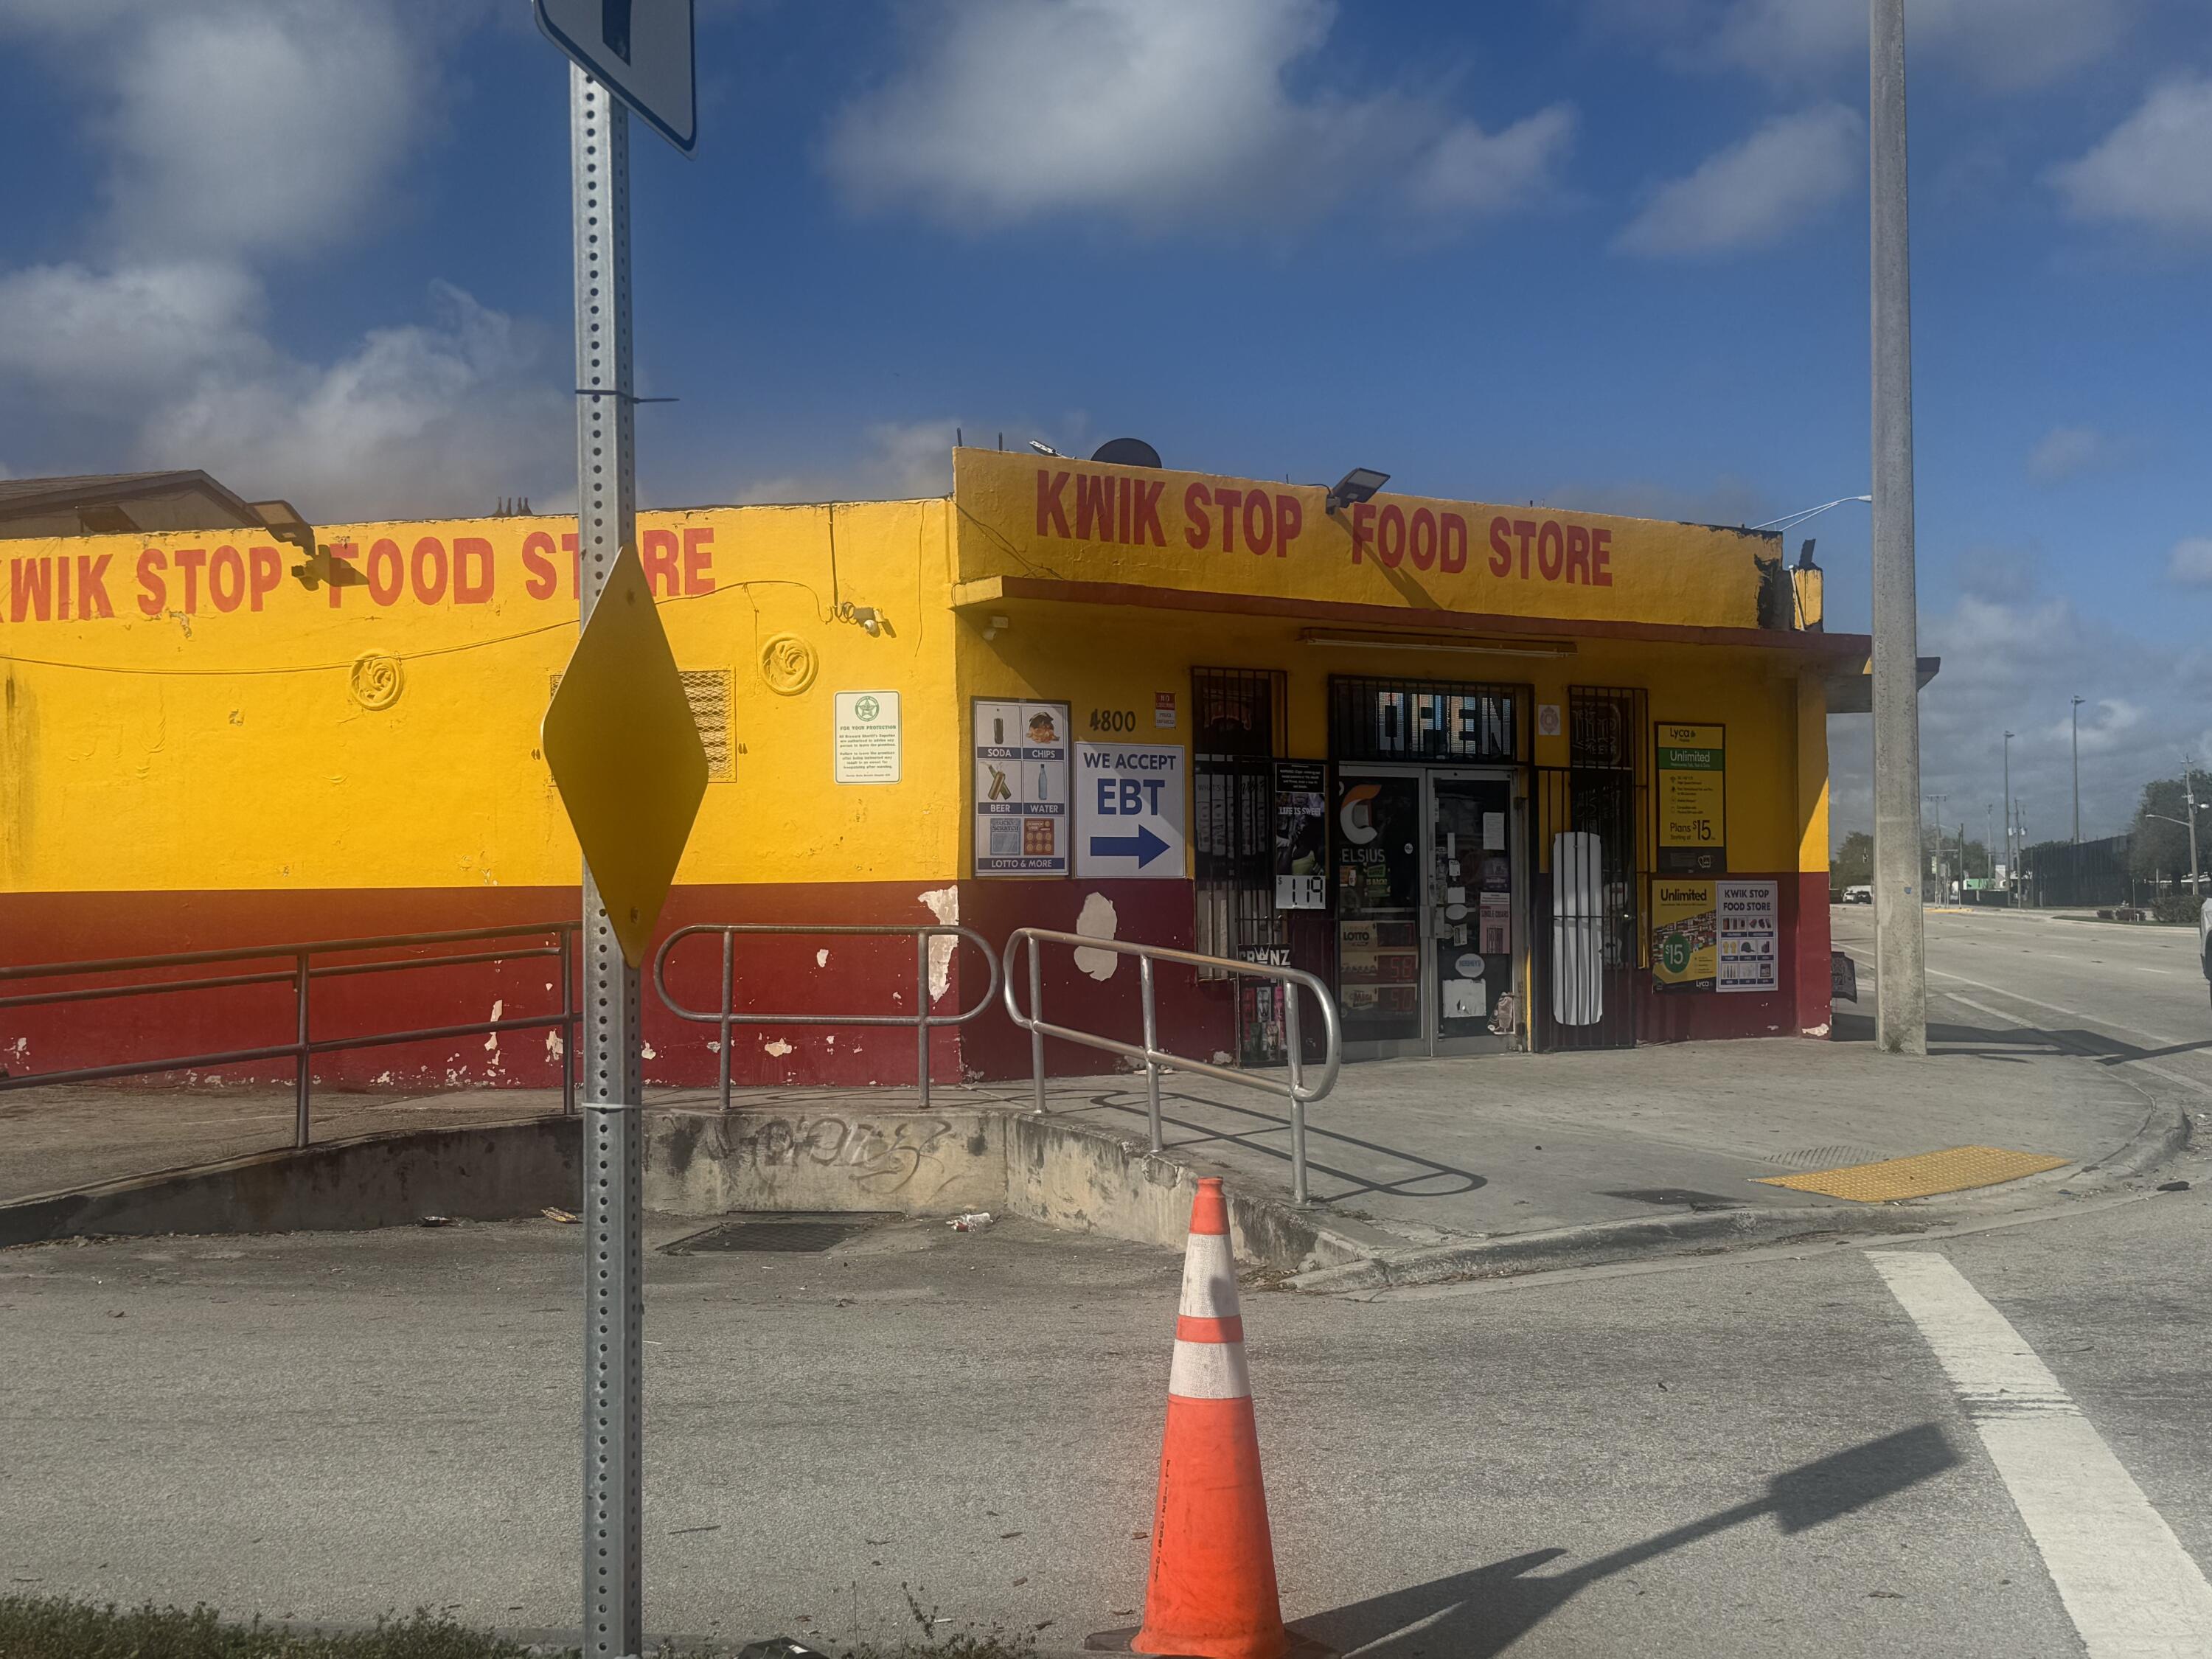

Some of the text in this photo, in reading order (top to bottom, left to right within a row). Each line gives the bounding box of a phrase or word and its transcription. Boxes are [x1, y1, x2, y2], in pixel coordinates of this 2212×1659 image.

[1036, 470, 1613, 587] KWIK STOP FOOD STORE
[0, 527, 716, 624] WIK STOP FOOD STRE
[1089, 709, 1136, 732] 4800
[1378, 691, 1512, 756] OPEN
[987, 748, 1012, 757] SODA
[1032, 749, 1056, 759] CHIPS
[1669, 749, 1711, 762] Unlimited
[1083, 752, 1177, 771] WE ACCEPT
[1097, 778, 1166, 815] EBT
[990, 804, 1011, 813] BEER
[1029, 804, 1058, 813] WATER
[1670, 819, 1711, 841] Plans $15
[991, 859, 1052, 868] LOTTO & MORE
[1660, 888, 1707, 901] Unlimited
[1724, 889, 1770, 898] KWIK STOP
[1723, 902, 1771, 911] FOOD STORE
[1343, 931, 1370, 941] LOTTO
[1665, 944, 1684, 965] $15
